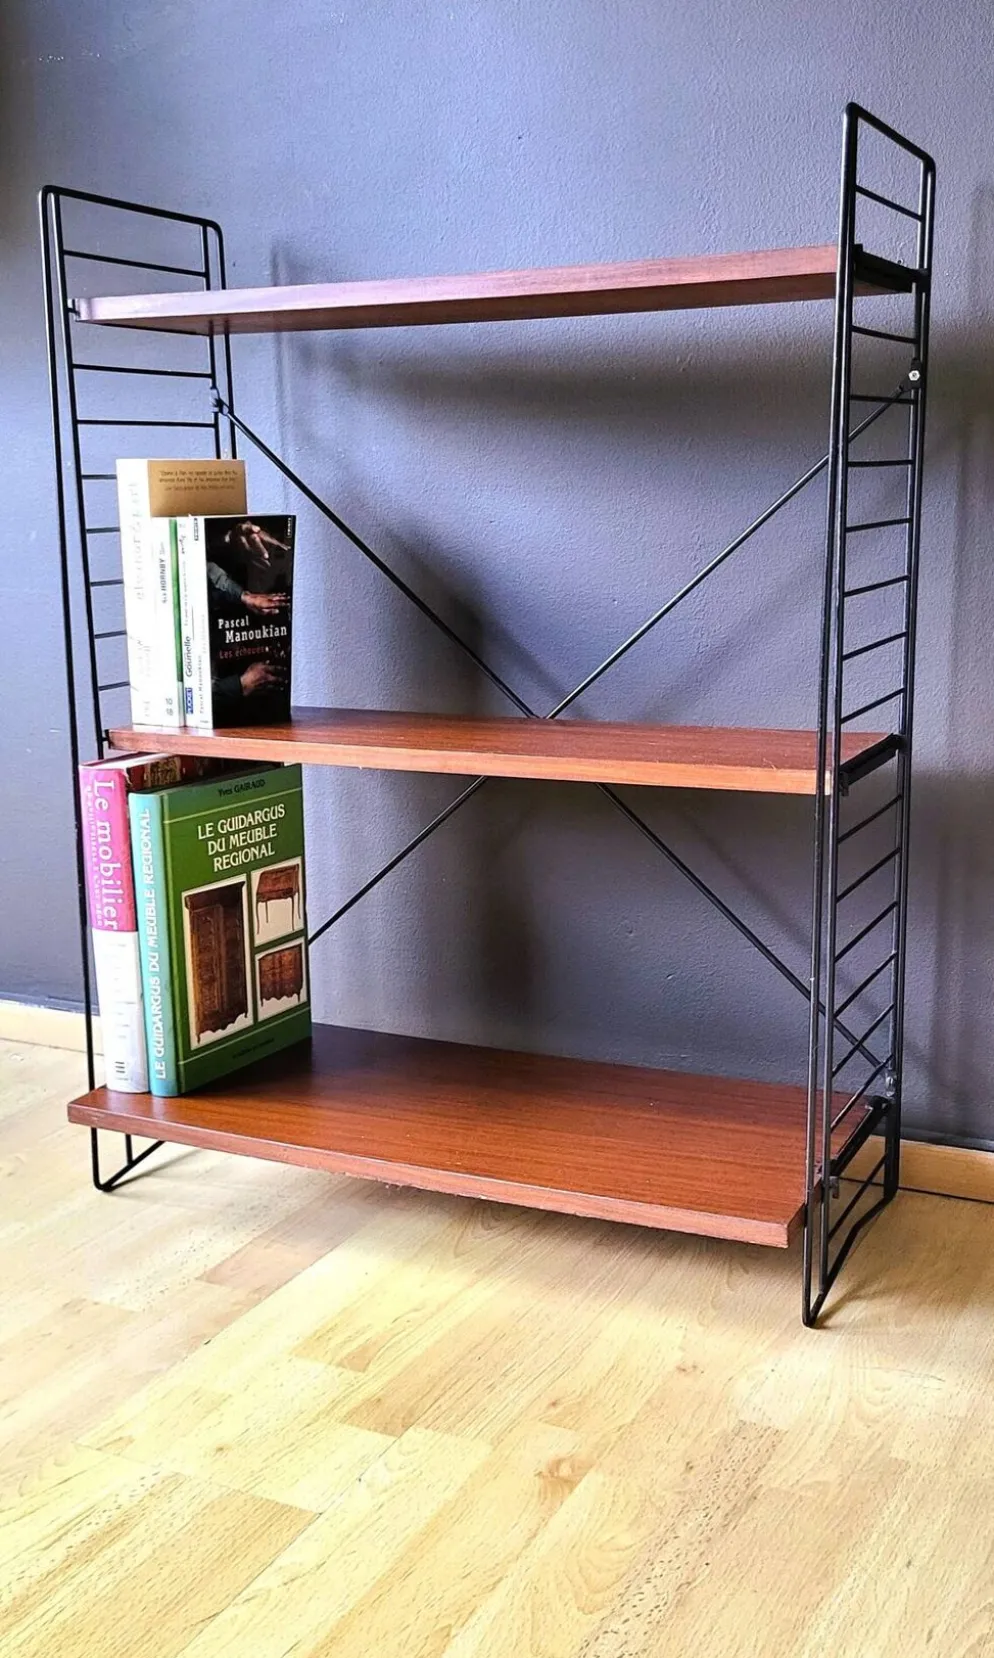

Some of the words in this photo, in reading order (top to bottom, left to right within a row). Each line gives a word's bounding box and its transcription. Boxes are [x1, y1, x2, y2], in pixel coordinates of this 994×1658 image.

[218, 615, 249, 629] Pascal
[225, 624, 288, 643] Manoukian
[184, 636, 193, 678] Gounelle
[93, 780, 115, 811] Le
[218, 788, 233, 797] Yves
[198, 823, 215, 840] LE
[217, 804, 286, 834] GUIDARGUS
[141, 808, 154, 884] REGIONAL
[207, 837, 226, 855] DU
[229, 823, 278, 850] MEUBLE
[213, 842, 275, 872] REGIONAL
[96, 820, 124, 931] mobilier
[144, 888, 158, 948] MEUBLE
[148, 952, 160, 972] DU
[150, 976, 165, 1058] GUIDARGUS
[154, 1061, 166, 1079] LE
